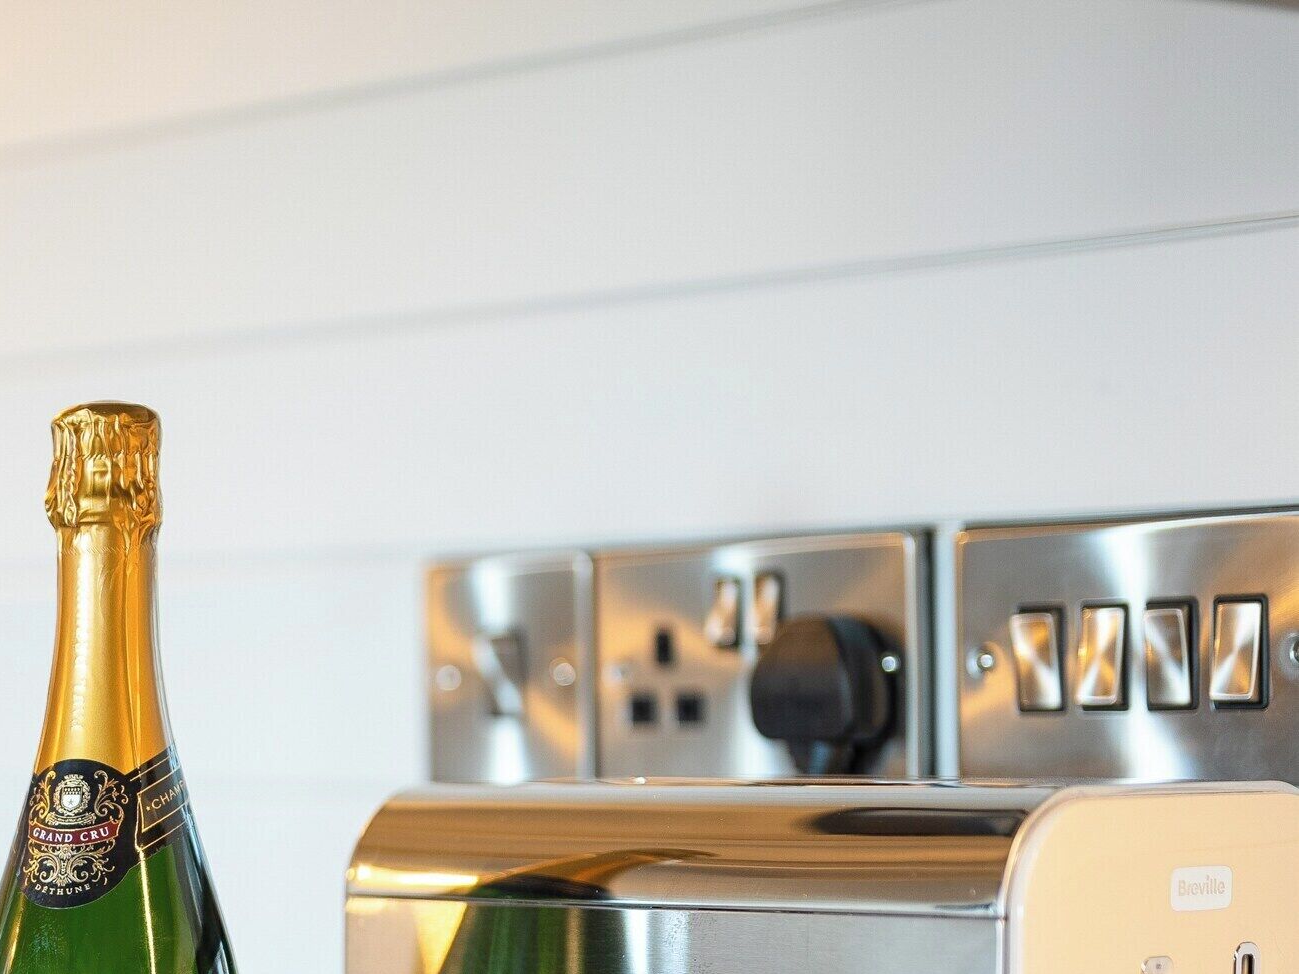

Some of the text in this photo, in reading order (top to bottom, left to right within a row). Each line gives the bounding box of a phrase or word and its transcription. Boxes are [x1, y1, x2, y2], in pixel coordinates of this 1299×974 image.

[32, 827, 110, 843] GRAND CRU
[34, 882, 92, 896] DÉTHUNE
[1178, 874, 1226, 897] Breville
